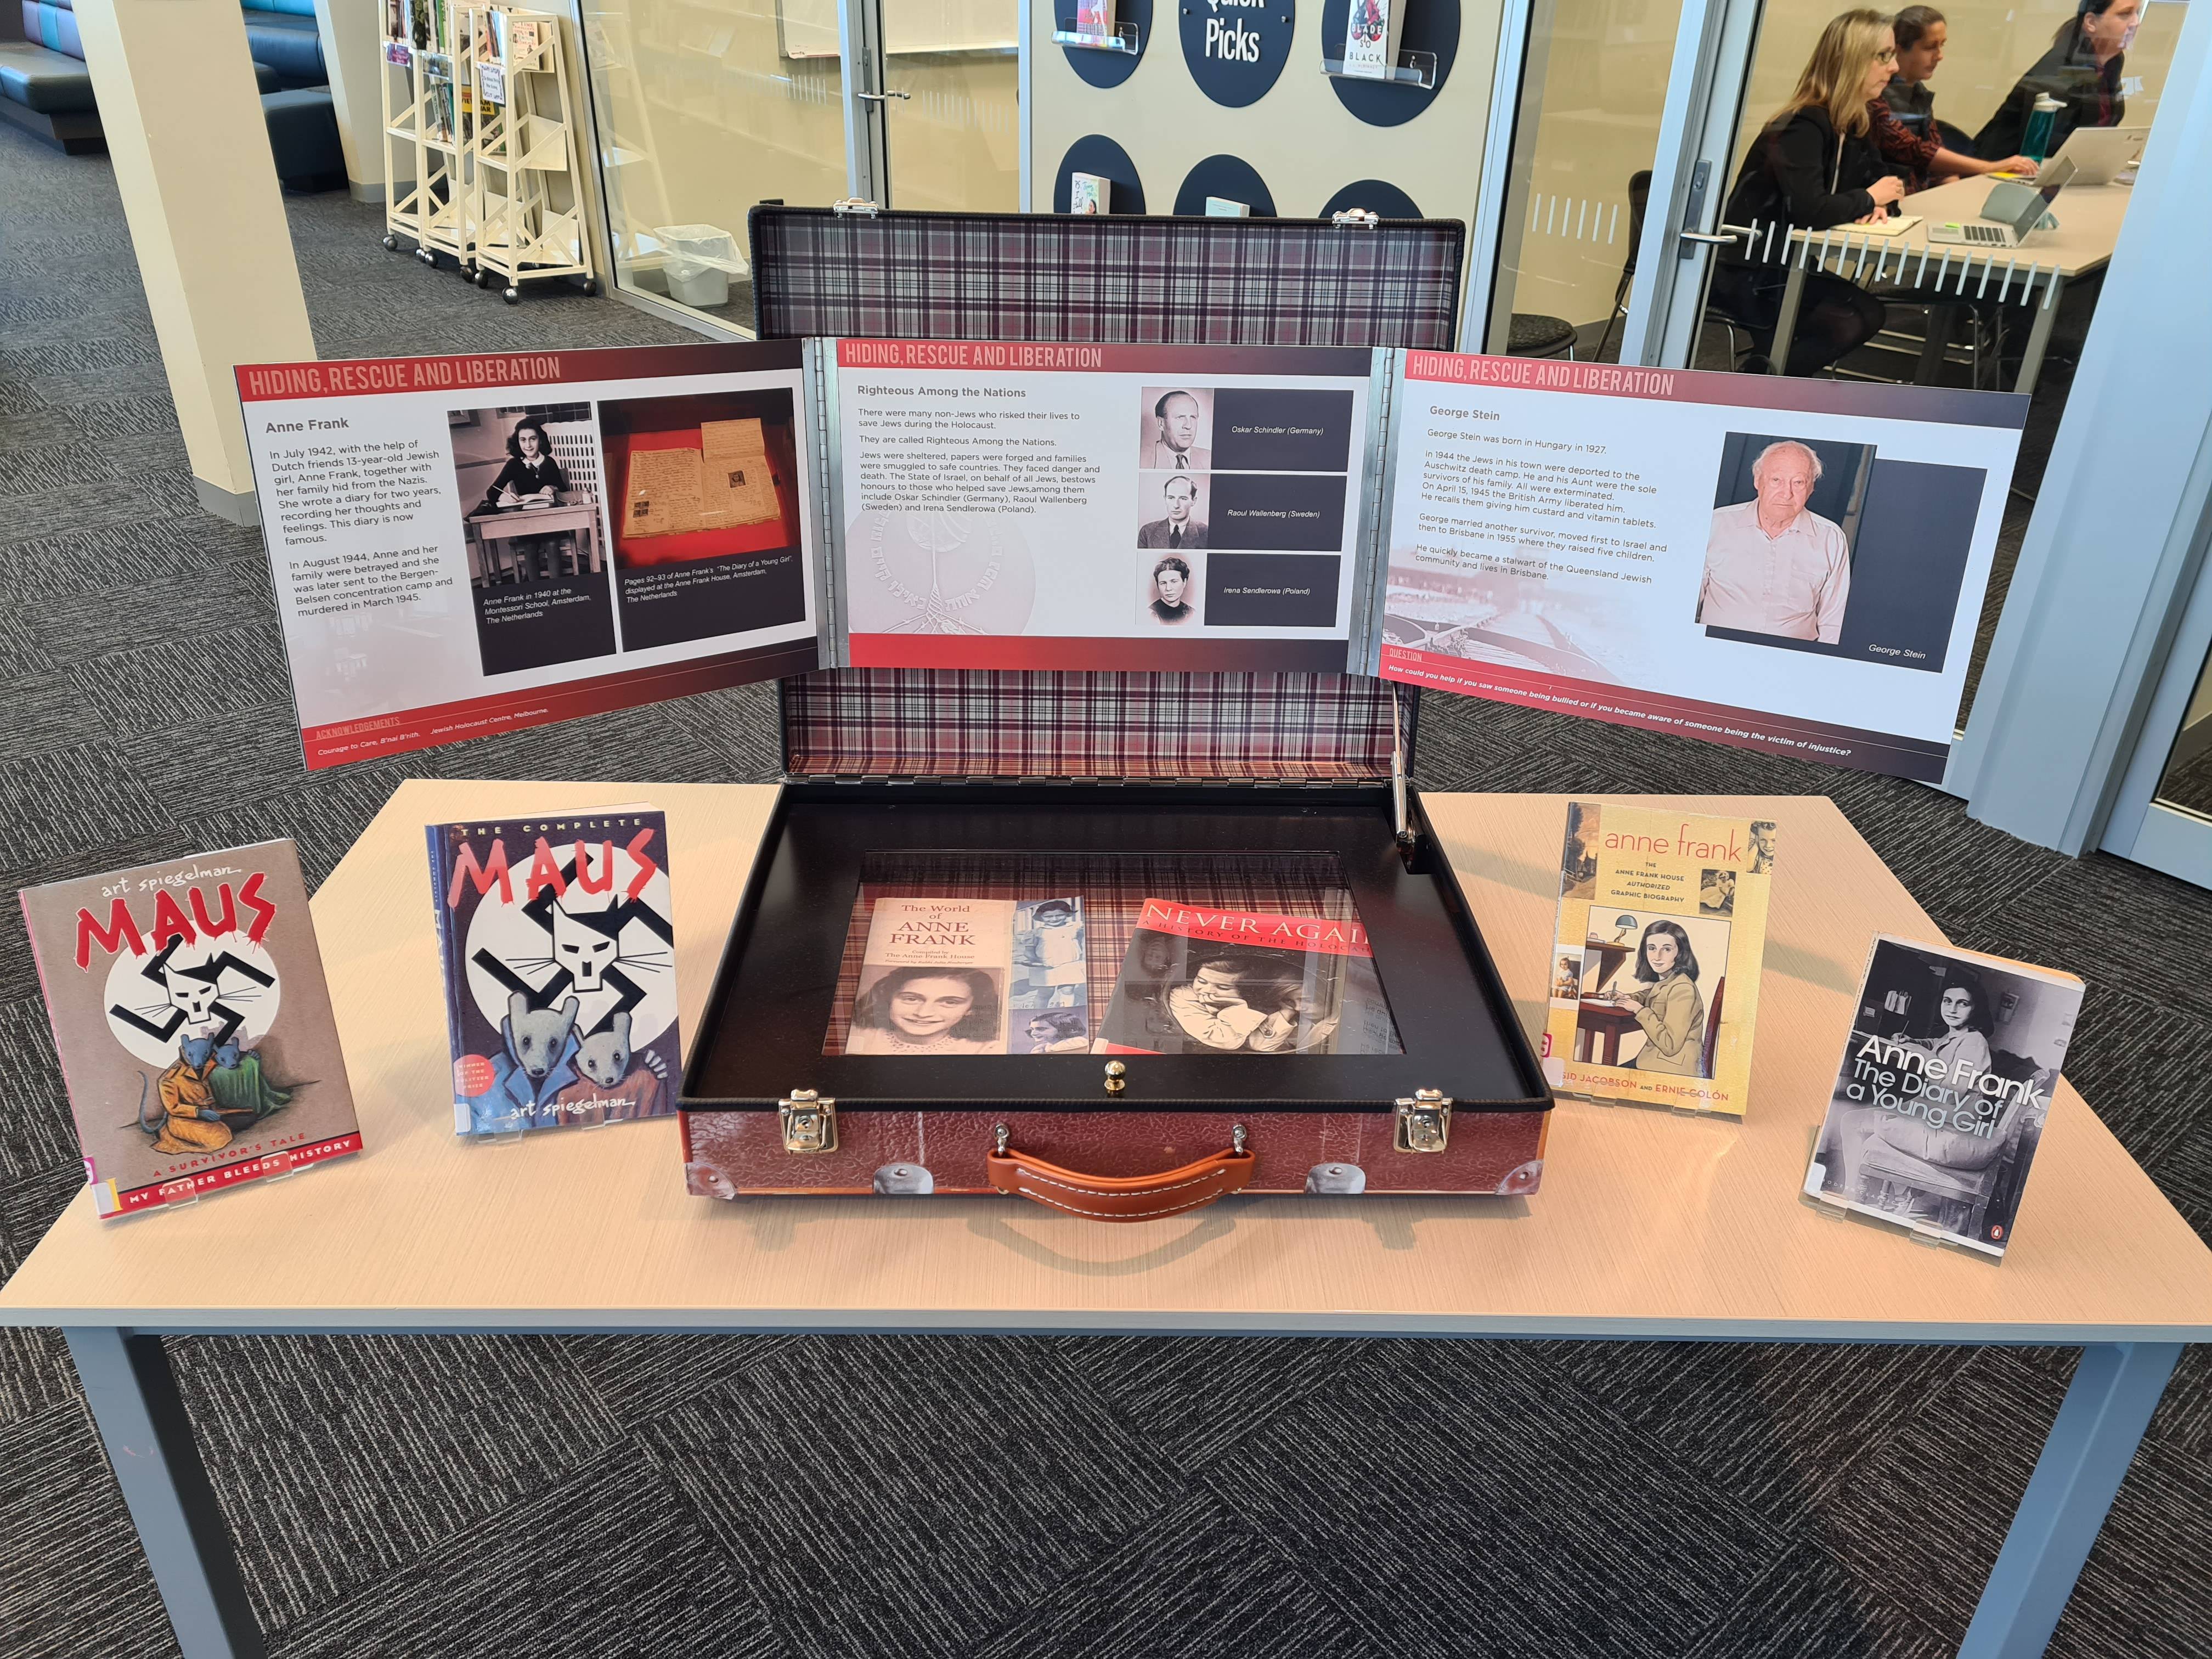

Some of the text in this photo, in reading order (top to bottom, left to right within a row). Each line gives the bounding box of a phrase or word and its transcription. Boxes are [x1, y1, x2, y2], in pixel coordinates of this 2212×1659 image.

[1351, 22, 1383, 35] BLADE
[1205, 18, 1260, 63] Picks
[1360, 40, 1371, 48] SO
[1350, 52, 1383, 64] BLACK
[845, 342, 1101, 367] HIDING, RESCUE AND LIBERATION
[249, 356, 560, 395] HIDING, RESCUE AND LIBERATION
[1413, 355, 1674, 395] HIDING, RESCUE AND LIBERATION
[857, 385, 1026, 397] Righteous Among the Nations
[1430, 405, 1499, 420] George Stein
[266, 417, 349, 433] Anne Frank
[1287, 427, 1323, 436] (Germany)
[283, 449, 304, 458] July
[307, 446, 335, 456] 1942,
[338, 444, 360, 454] with
[363, 443, 380, 452] the
[383, 441, 405, 450] help
[408, 439, 417, 448] of
[1249, 510, 1286, 518] Wallenberg
[1288, 510, 1319, 518] (Sweden)
[484, 595, 590, 615] Montessori School, Amsterdam,
[504, 594, 524, 602] Frank
[534, 590, 550, 598] 1940
[1389, 647, 1422, 662] QUESTION
[1869, 644, 1926, 659] George Stein
[1439, 674, 1455, 683] help
[1493, 685, 1527, 696] someone
[1528, 691, 1550, 701] being
[1551, 695, 1579, 705] bullied
[1613, 706, 1646, 718] became
[1647, 714, 1672, 723] aware
[1684, 721, 1723, 732] someone
[1724, 727, 1749, 738] being
[1751, 732, 1765, 740] the
[1768, 736, 1795, 746] victim
[1808, 742, 1851, 755] injustice?
[461, 818, 641, 837] THE COMPLETE
[1605, 823, 1741, 862] anne frank
[447, 827, 658, 910] MAUS
[1636, 871, 1659, 879] FRANK
[1661, 873, 1685, 882] HOUSE
[101, 864, 242, 898] art spiegelman
[1627, 881, 1671, 891] AUTHORIZED
[1611, 889, 1685, 903] GRAPHIC BIOGRAPHY
[931, 905, 970, 913] World
[73, 872, 276, 972] MAUS
[898, 922, 969, 932] ANNE
[1146, 904, 1260, 934] NEVER
[889, 933, 976, 945] FRANK
[1158, 922, 1224, 938] HISTORY
[1258, 936, 1286, 945] THE
[1856, 1035, 2045, 1109] Anne Frank
[1580, 1074, 1637, 1089] JACOBSON
[1655, 1083, 1686, 1095] ERNIE
[1689, 1086, 1729, 1102] COLÓN
[1854, 1058, 2004, 1119] The Diary of
[510, 1092, 636, 1120] art spiegelman
[1846, 1083, 1996, 1139] a Young Girl
[153, 1132, 306, 1178] A SURVIVOR'S TALE
[129, 1139, 351, 1204] MY FATHER BLEEDS HISTORY
